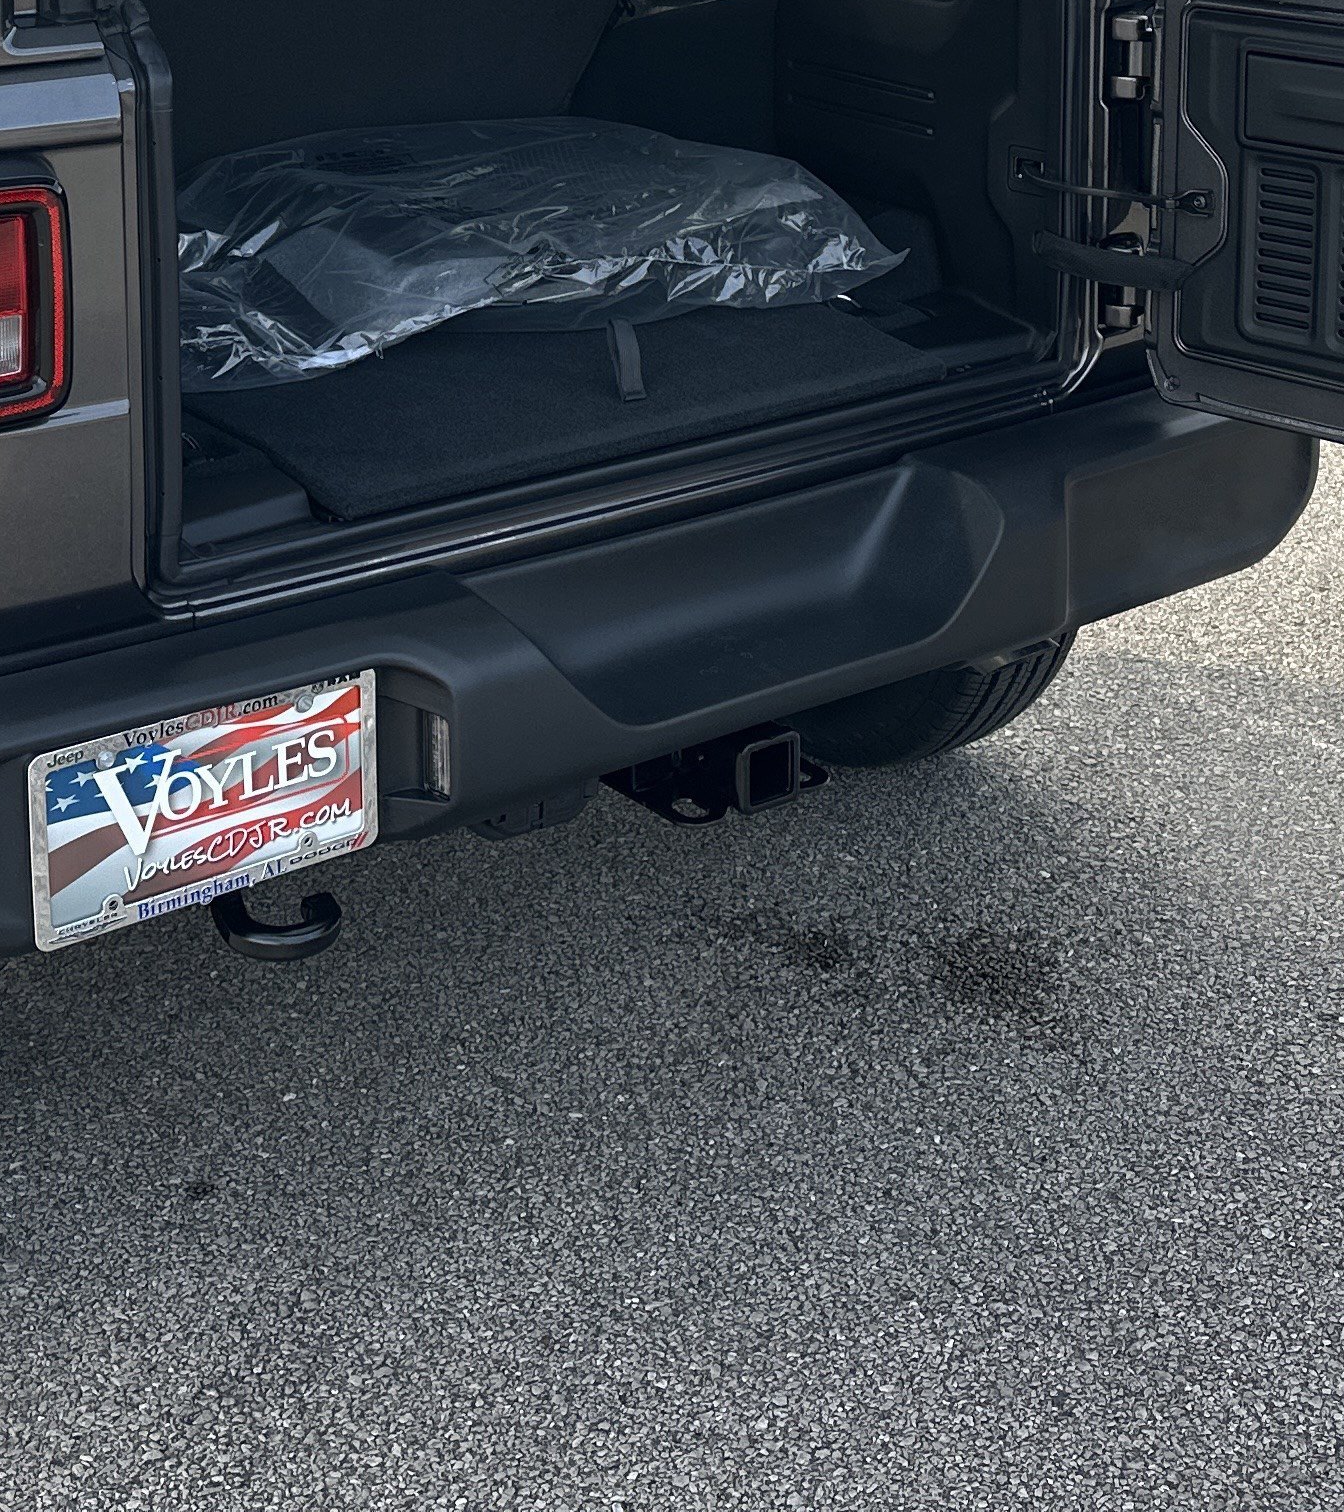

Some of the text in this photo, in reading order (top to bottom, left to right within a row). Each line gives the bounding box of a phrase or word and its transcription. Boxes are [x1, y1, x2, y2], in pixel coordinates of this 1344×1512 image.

[122, 694, 279, 749] VoylesCDJR.com
[47, 748, 85, 769] Jeep
[93, 729, 339, 856] VOYLES
[138, 859, 287, 921] Birmingham, AL
